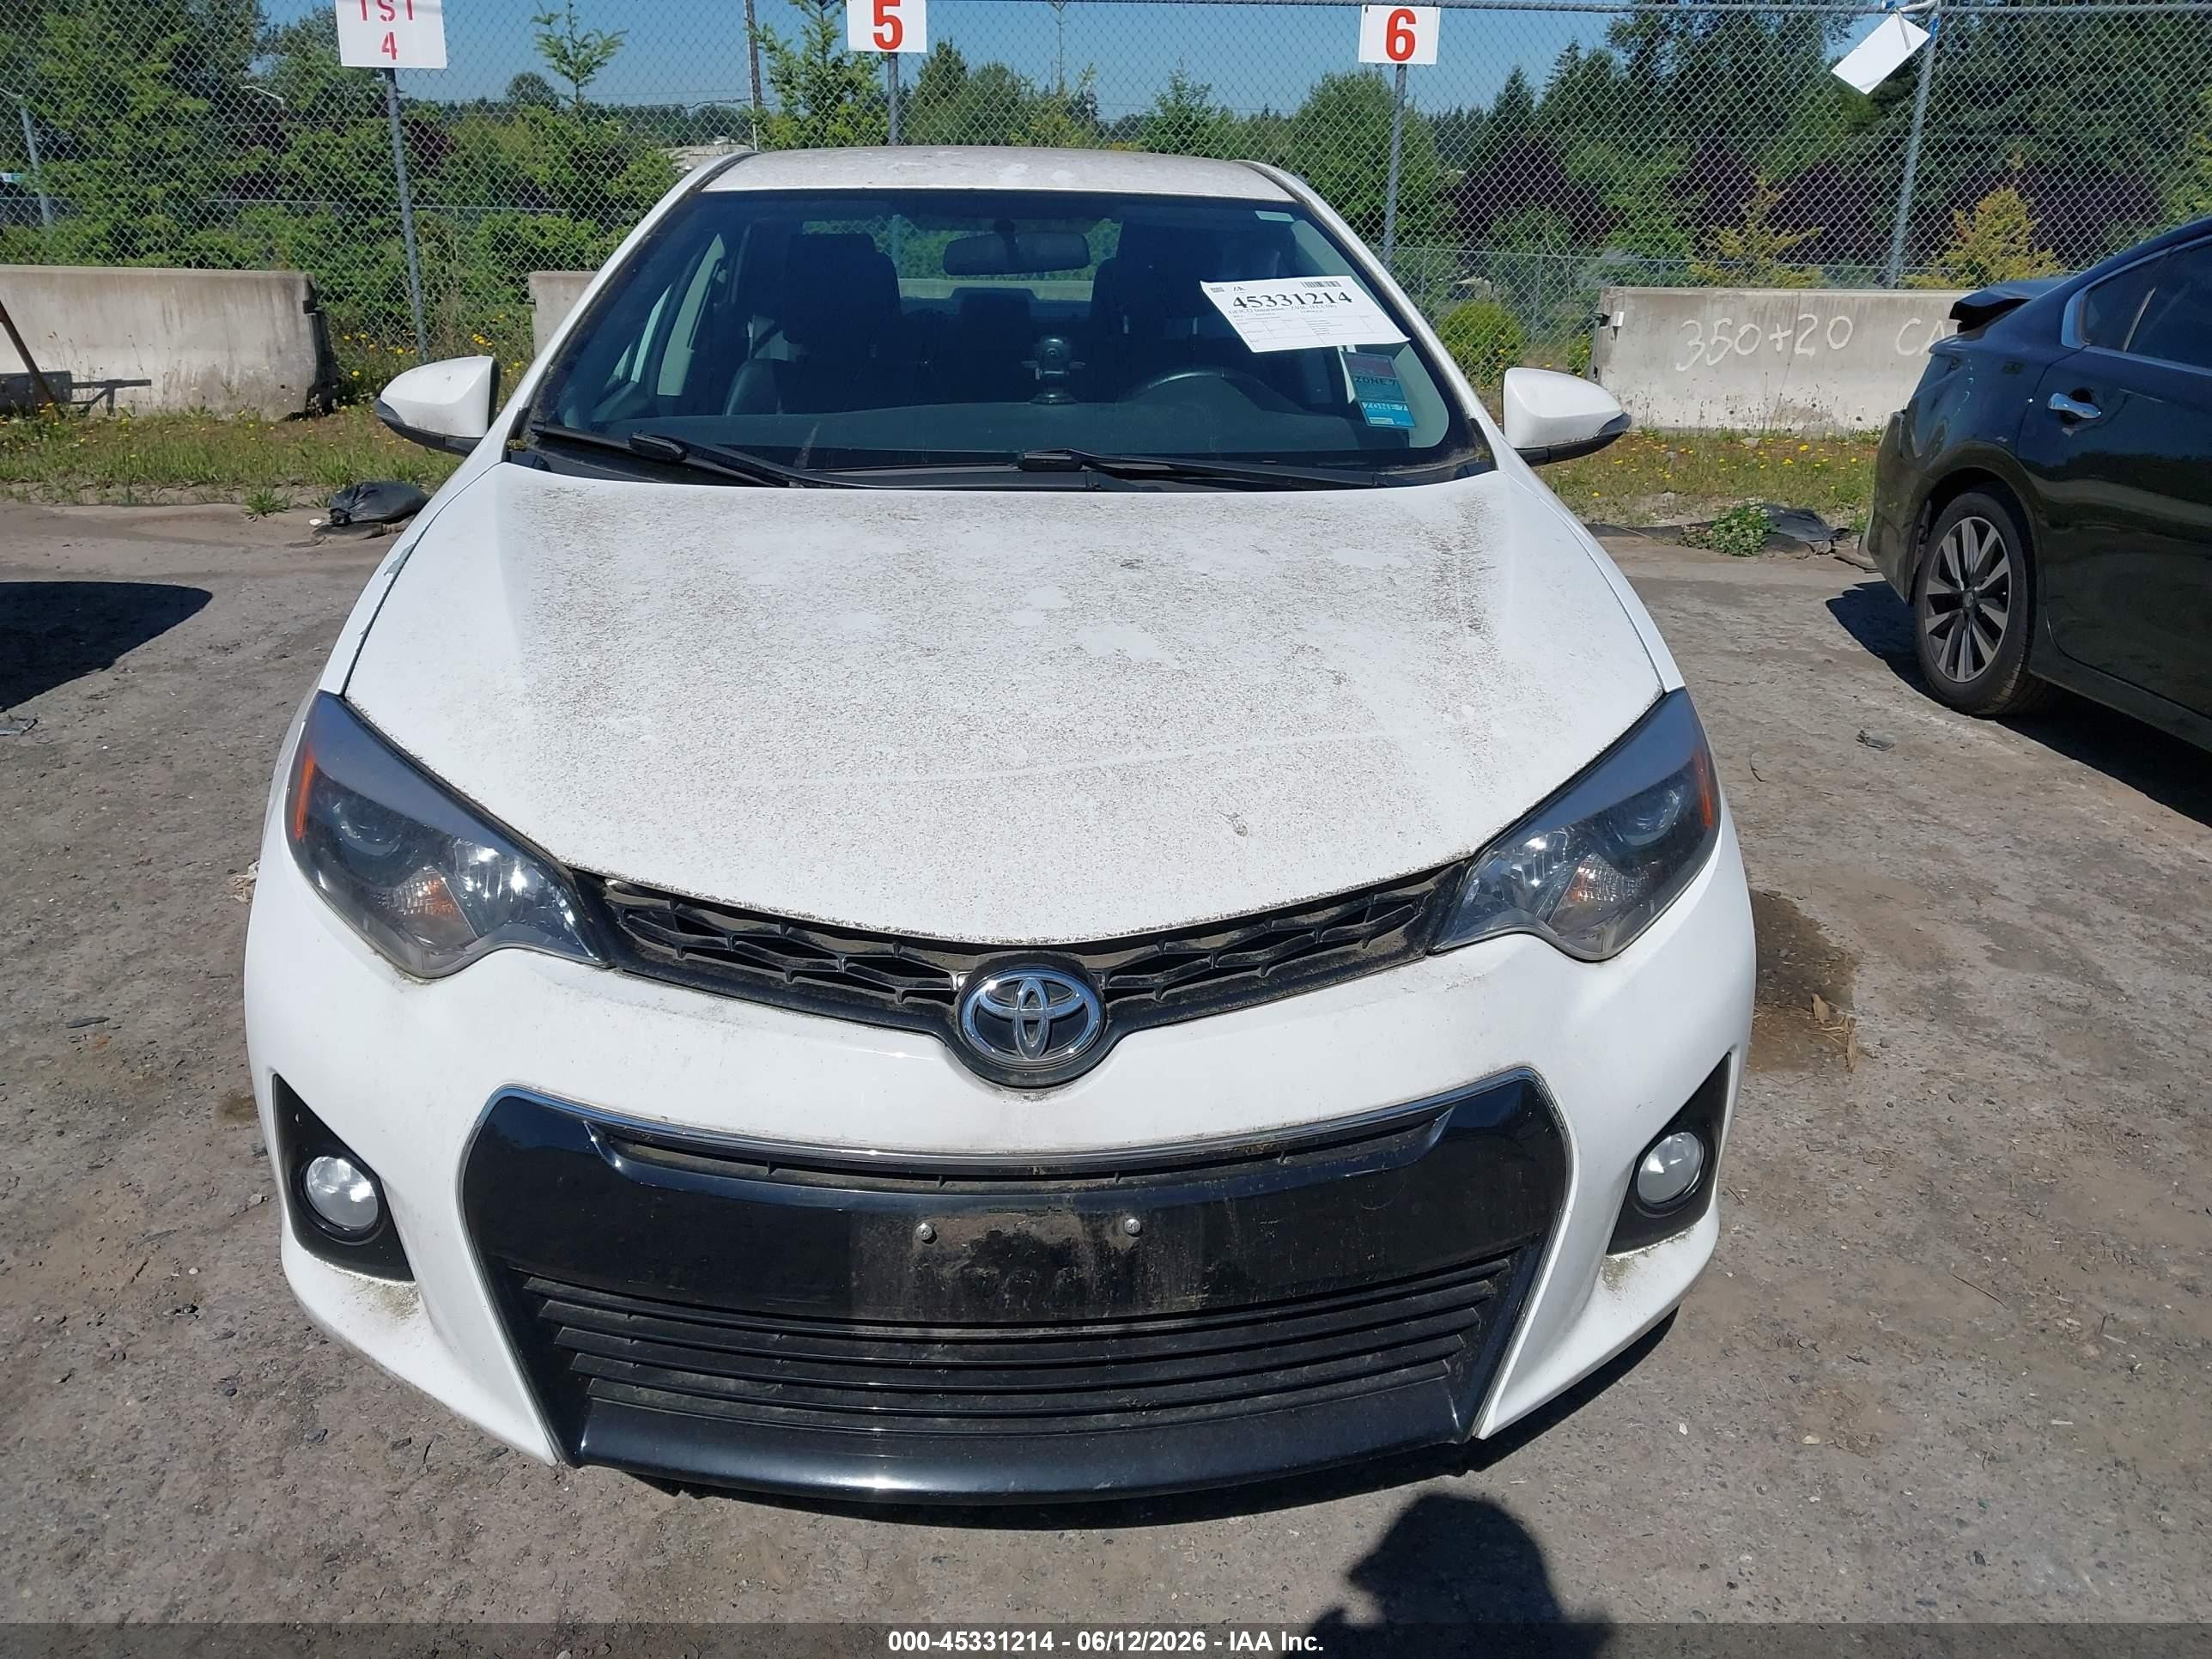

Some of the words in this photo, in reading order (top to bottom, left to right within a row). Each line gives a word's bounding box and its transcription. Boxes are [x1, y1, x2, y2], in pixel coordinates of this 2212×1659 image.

[381, 31, 398, 60] 4
[872, 0, 903, 51] 5
[1386, 8, 1417, 62] 6
[1232, 291, 1352, 309] 45331214
